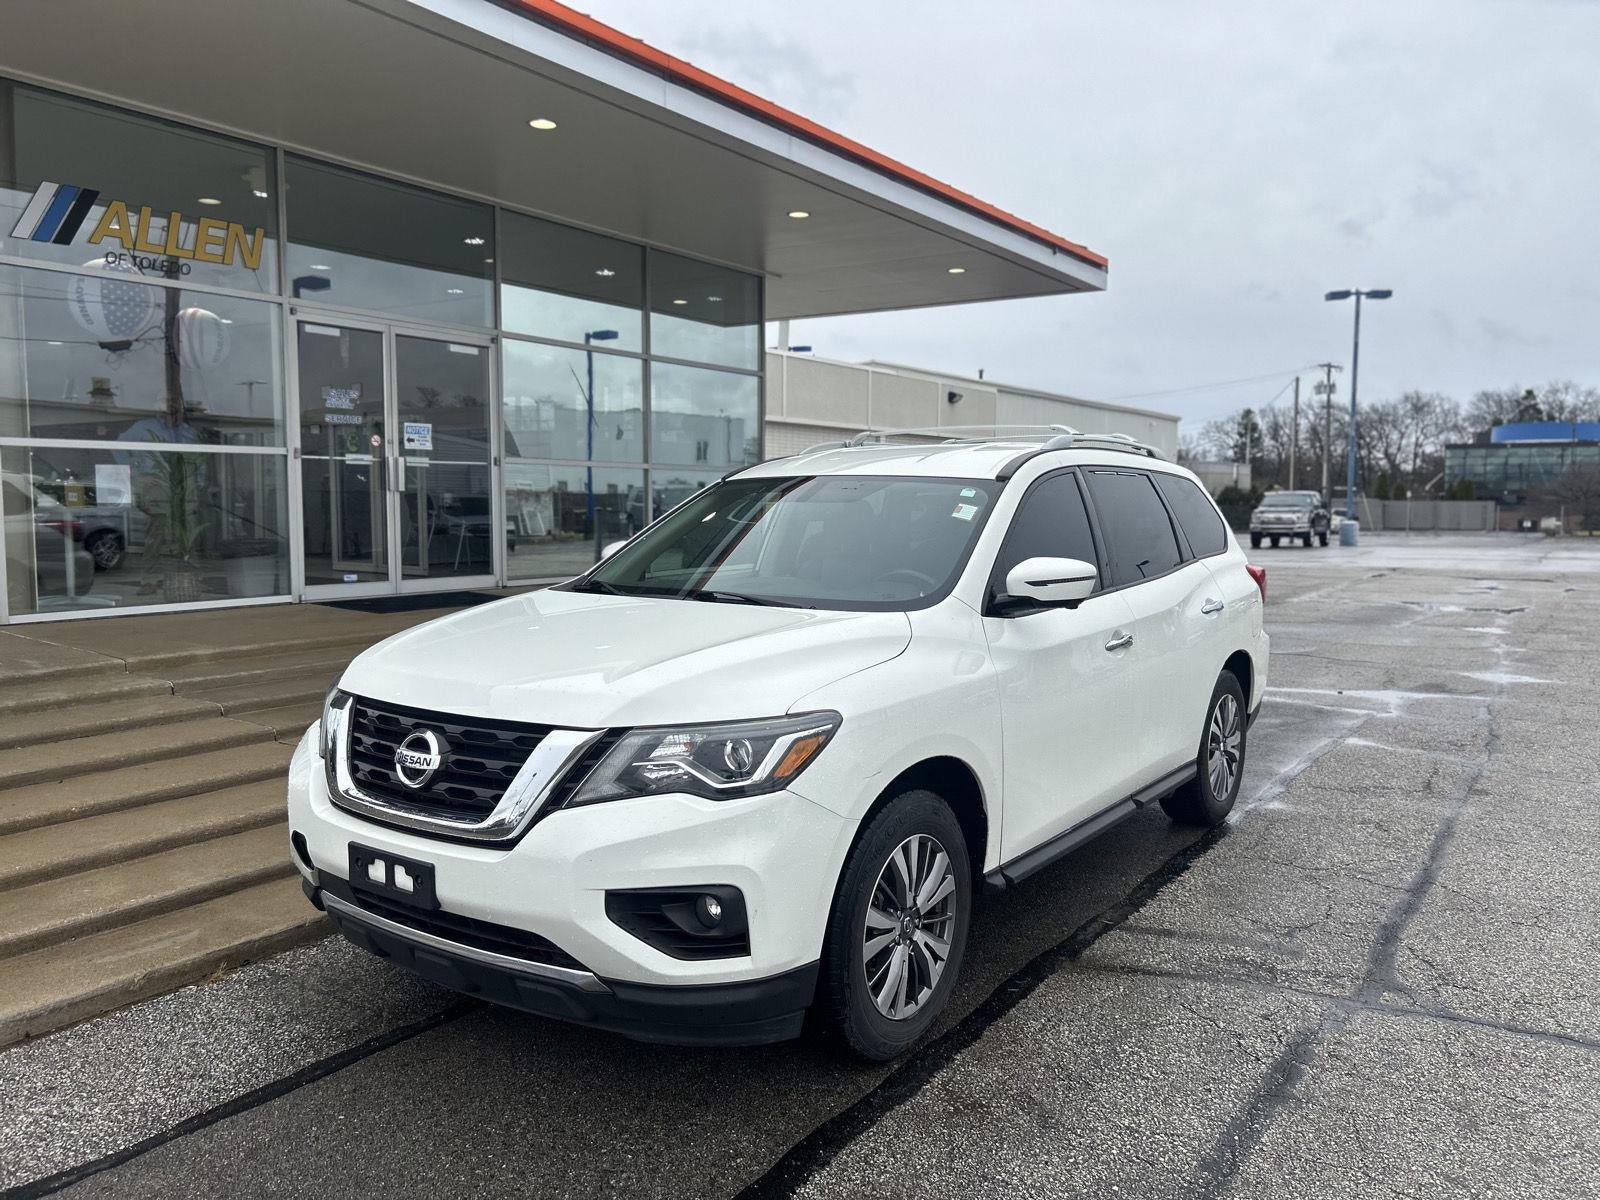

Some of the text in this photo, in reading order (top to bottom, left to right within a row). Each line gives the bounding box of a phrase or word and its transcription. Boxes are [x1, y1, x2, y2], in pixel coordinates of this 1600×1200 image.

[88, 199, 265, 271] ALLEN
[105, 251, 192, 276] OF TOLEDO
[325, 414, 362, 424] SERVICE
[406, 426, 429, 435] NOTICE
[396, 750, 432, 767] NISSAN
